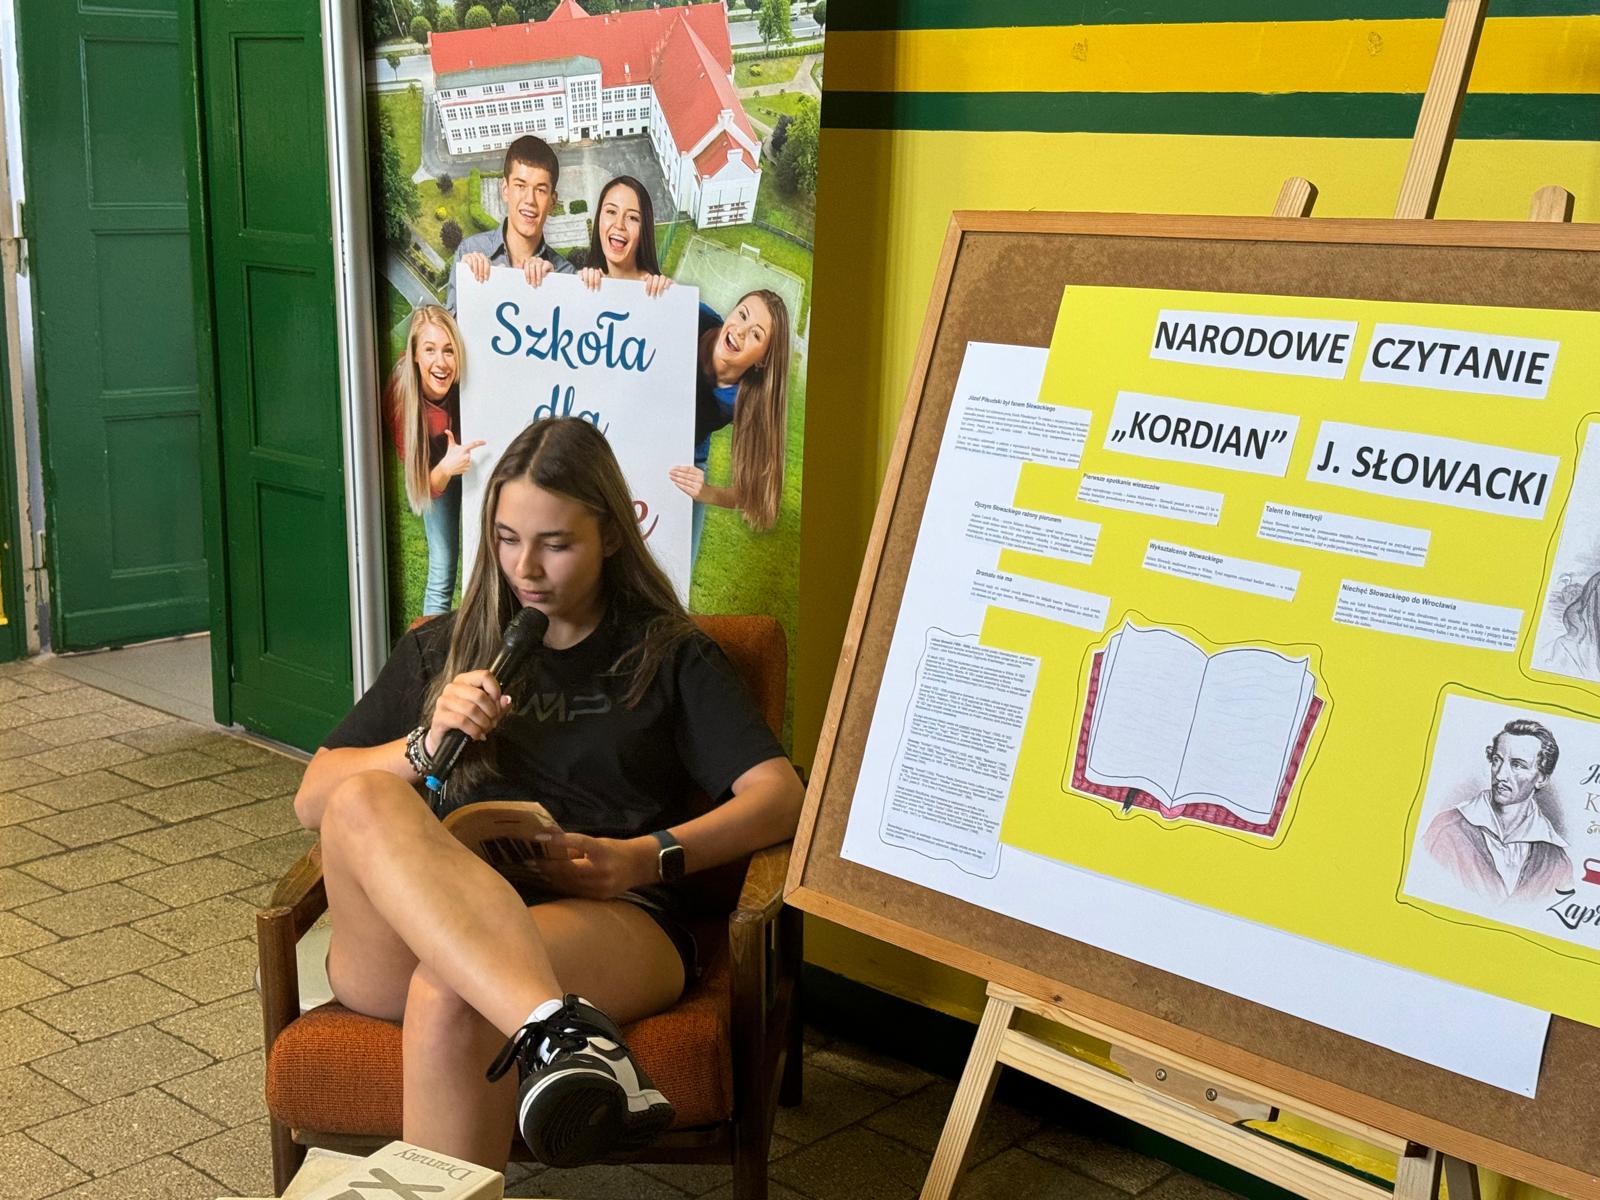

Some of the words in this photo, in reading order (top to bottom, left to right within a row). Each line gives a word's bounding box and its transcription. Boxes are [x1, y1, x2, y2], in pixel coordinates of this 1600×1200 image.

[491, 301, 657, 372] Szkoła
[1155, 321, 1350, 364] NARODOWE
[1372, 337, 1550, 385] CZYTANIE
[1111, 411, 1288, 460] „KORDIAN”
[1317, 440, 1340, 474] J.
[1351, 446, 1548, 506] SŁOWACKI
[1266, 505, 1283, 515] Talent
[1369, 588, 1411, 603] Słowackiego
[1422, 598, 1457, 610] Wrocławia
